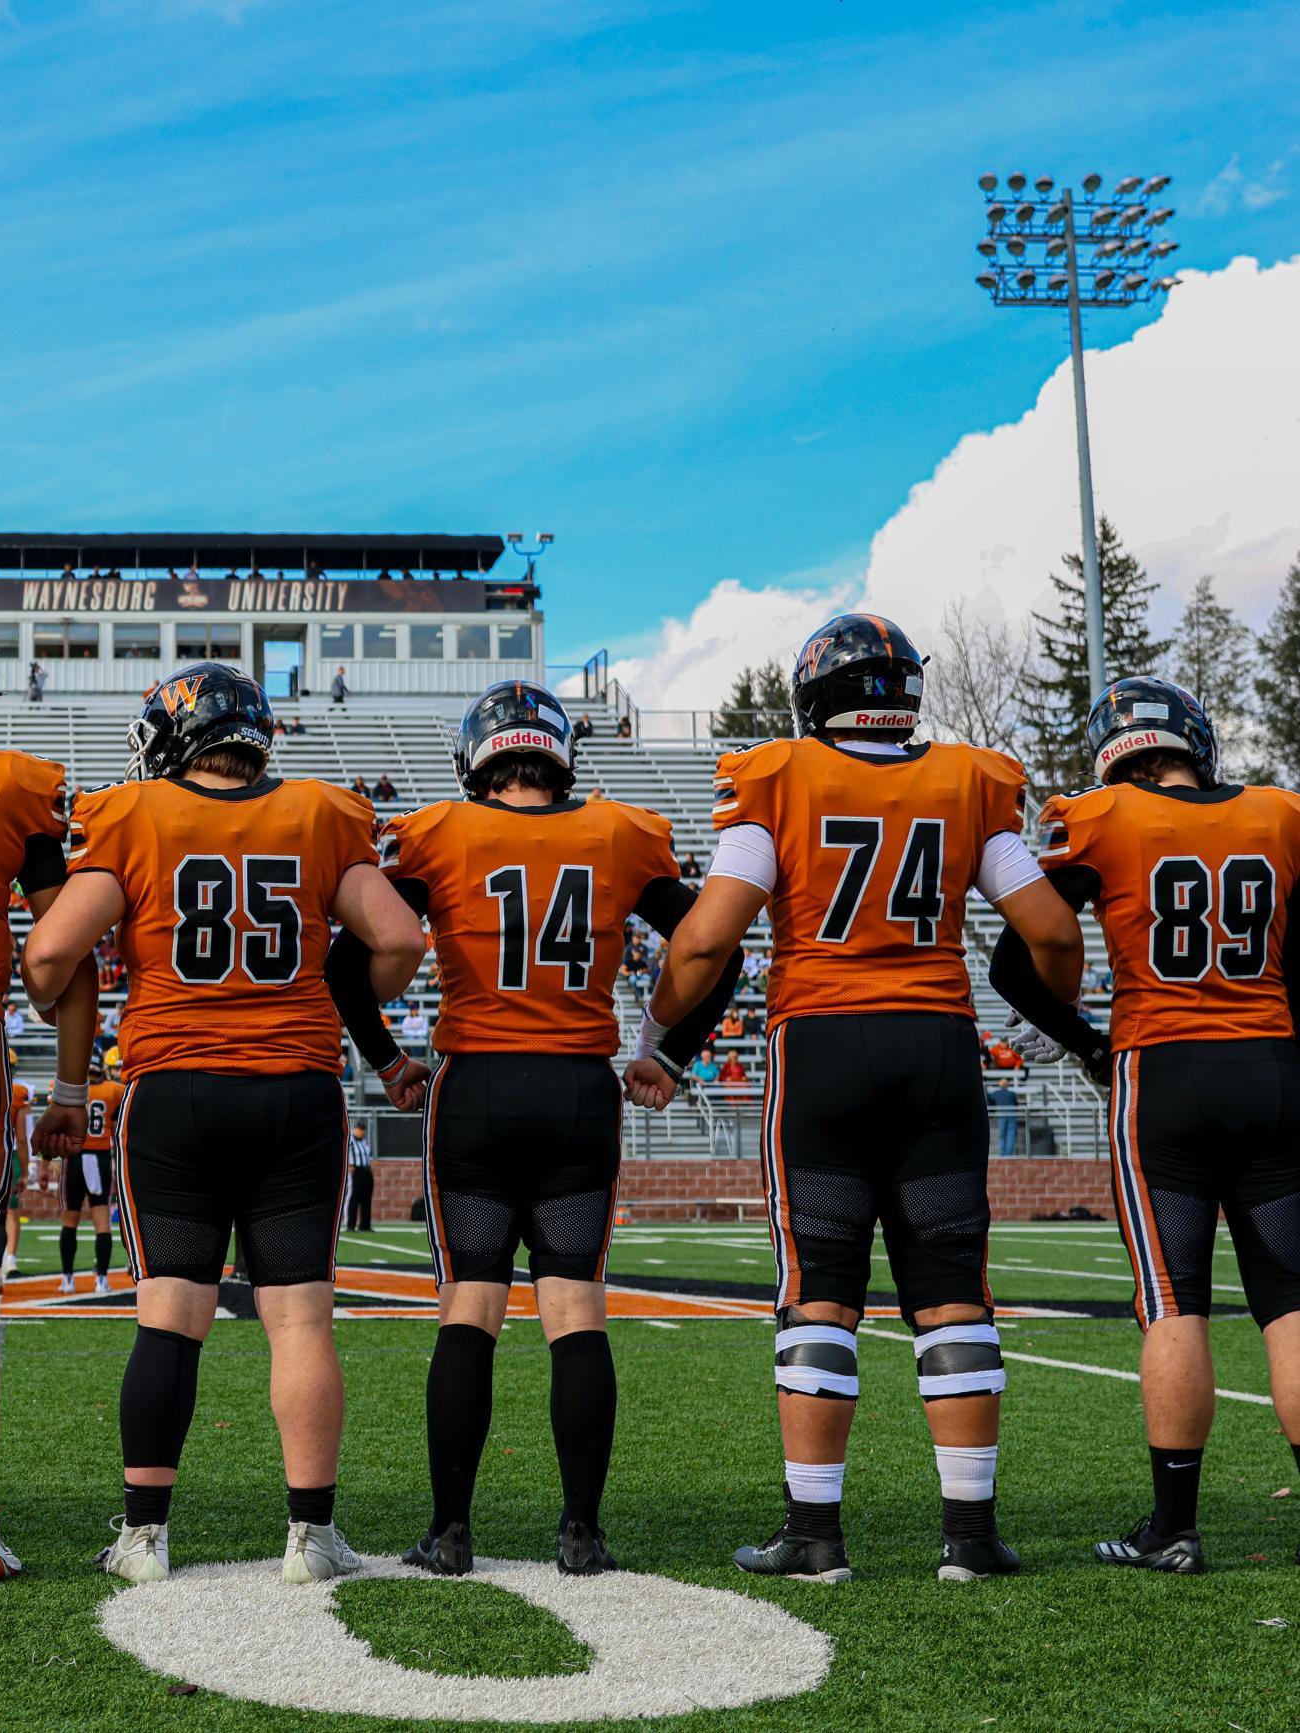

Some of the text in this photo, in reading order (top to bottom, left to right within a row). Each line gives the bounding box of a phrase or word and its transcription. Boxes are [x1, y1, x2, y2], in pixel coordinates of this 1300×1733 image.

[22, 581, 157, 611] WAYNESBURG
[227, 582, 348, 611] UNIVERSITY
[160, 674, 208, 720] W
[855, 713, 913, 726] Riddell
[491, 731, 553, 752] Riddell
[1101, 732, 1158, 763] Riddell
[816, 816, 945, 947] 74
[171, 854, 303, 984] 85
[485, 864, 595, 991] 14
[1148, 854, 1277, 983] 89
